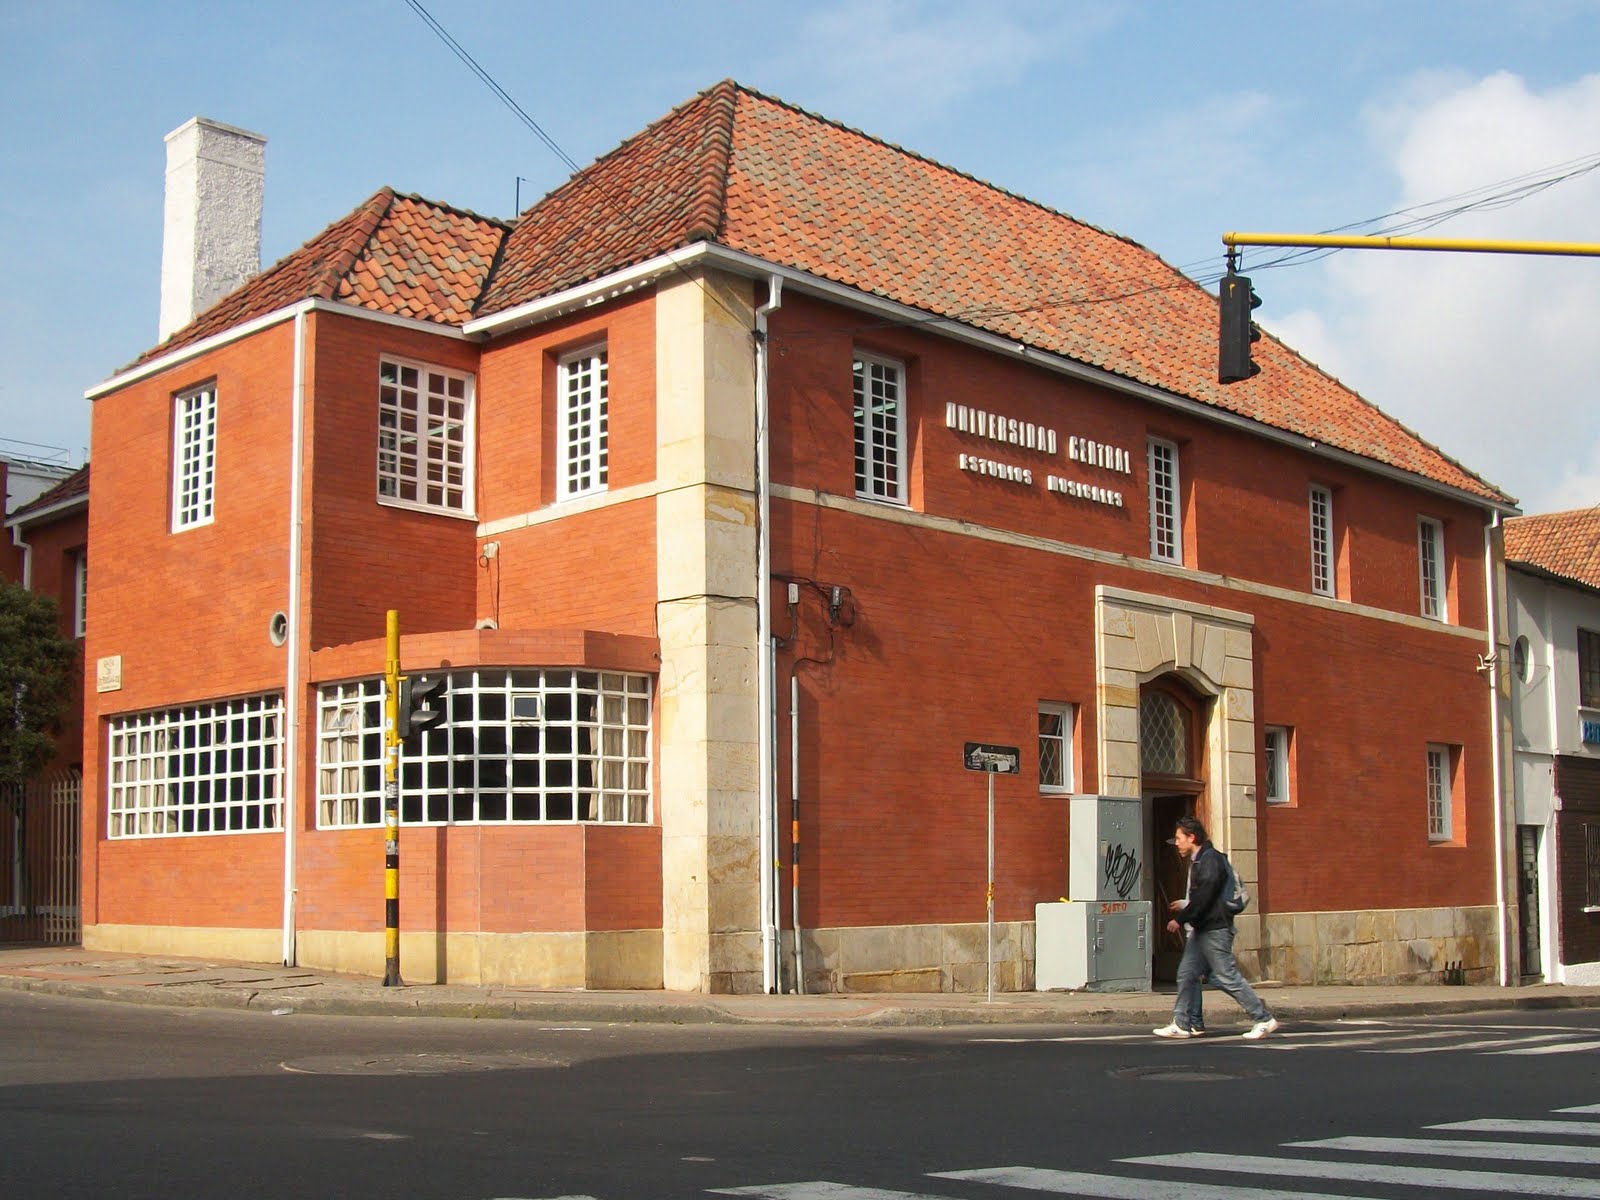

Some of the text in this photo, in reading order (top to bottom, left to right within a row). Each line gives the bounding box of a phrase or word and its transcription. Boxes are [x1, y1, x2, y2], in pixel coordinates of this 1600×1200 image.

[945, 401, 1131, 475] UNIVERSIDAD CENTRAL
[959, 453, 1123, 507] ESTUDIOS MUSICALES
